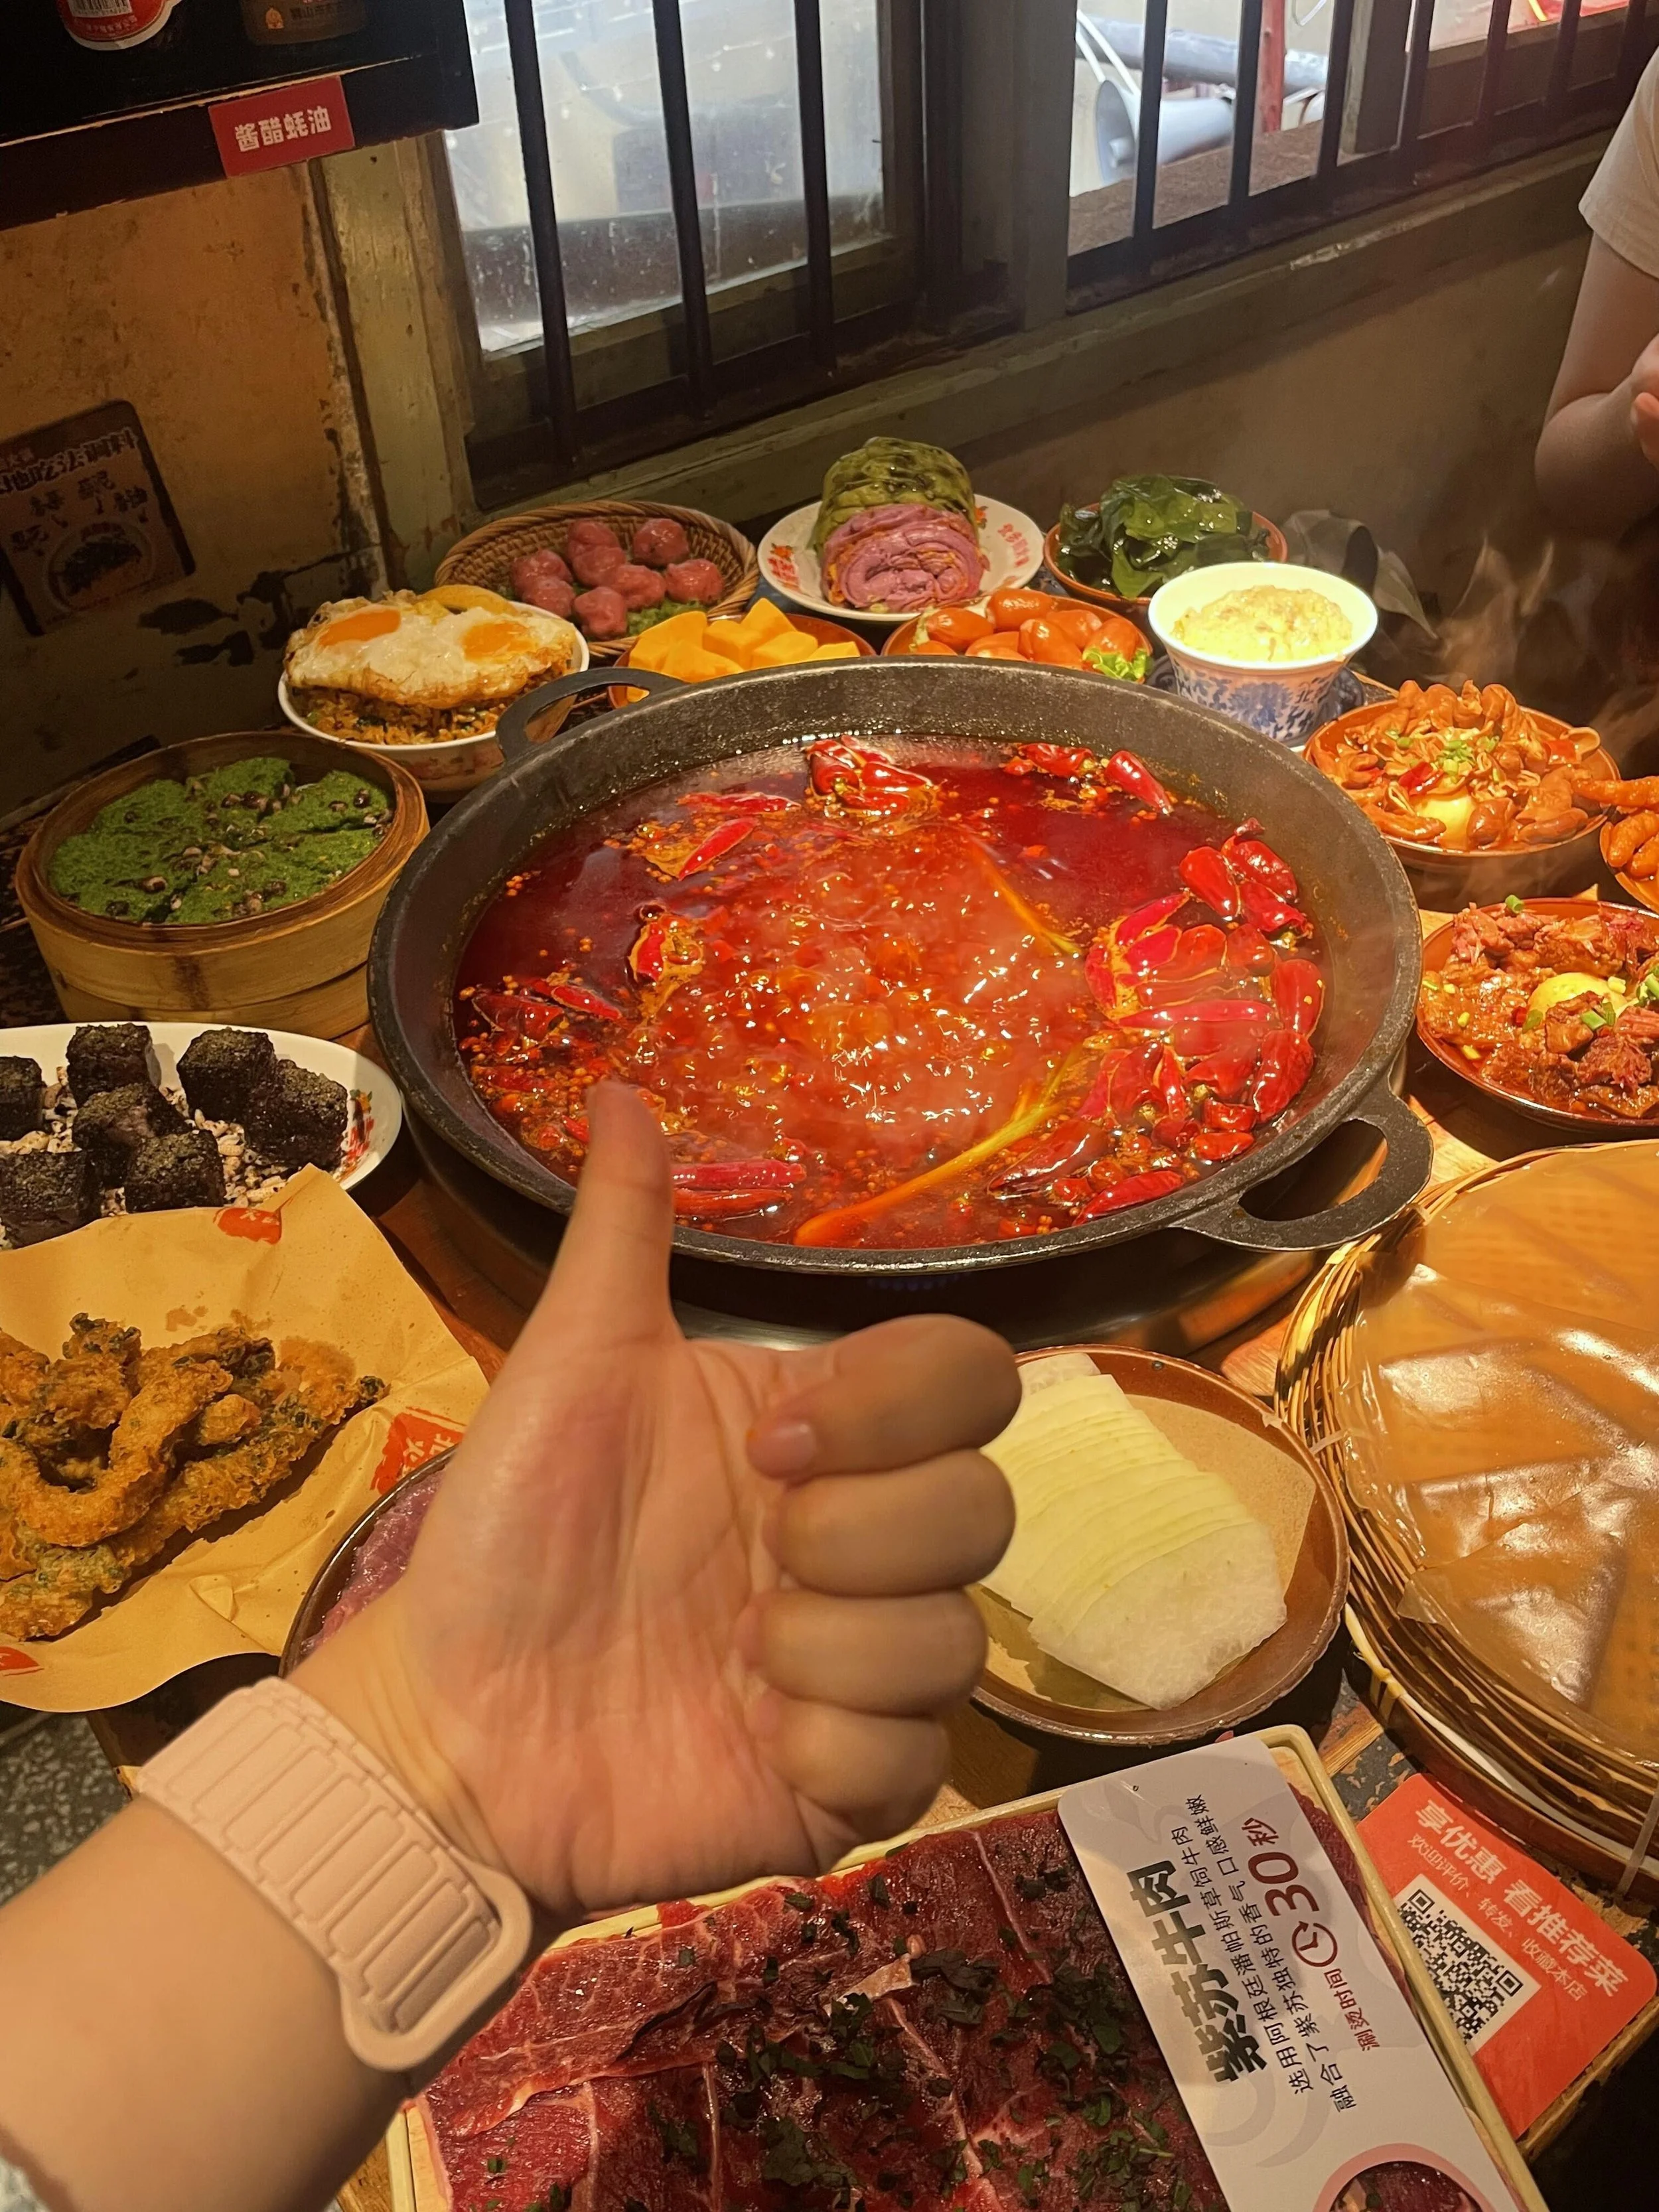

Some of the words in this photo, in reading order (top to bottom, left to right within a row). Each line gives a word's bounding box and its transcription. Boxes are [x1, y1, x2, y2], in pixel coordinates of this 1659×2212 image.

[234, 105, 332, 153] 酱醋蚝油
[1126, 1860, 1267, 2083] 紫苏牛肉
[1171, 1826, 1314, 2095] 选用阿根廷潘帕斯草饲牛肉
[1415, 1799, 1508, 1885] 享优惠
[1503, 1879, 1628, 1997] 看推荐菜
[1324, 1968, 1380, 2051] 涮烫时间
